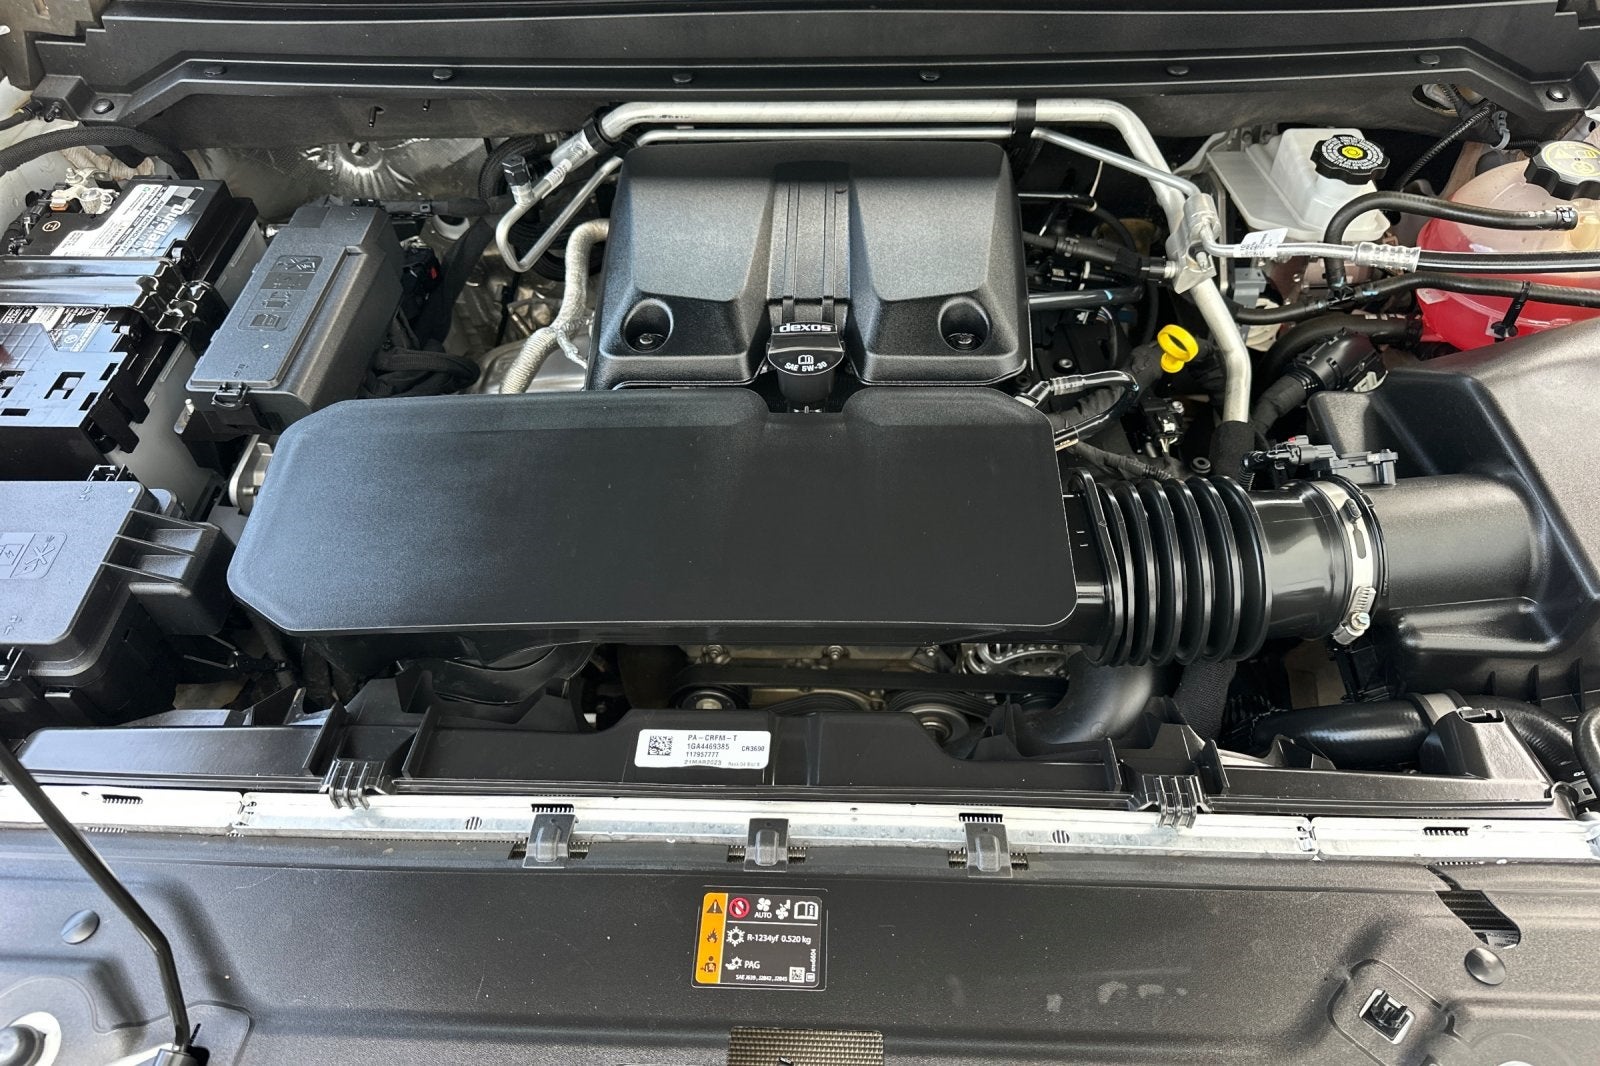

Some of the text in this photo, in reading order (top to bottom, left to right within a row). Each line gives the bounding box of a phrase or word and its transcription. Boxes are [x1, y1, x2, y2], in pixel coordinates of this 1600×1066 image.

[136, 203, 190, 252] Duralast
[779, 323, 832, 332] dexos
[785, 361, 827, 371] SAE 5W-30
[747, 935, 778, 943] R-1234yf
[802, 936, 811, 945] kg
[744, 961, 760, 969] PAG
